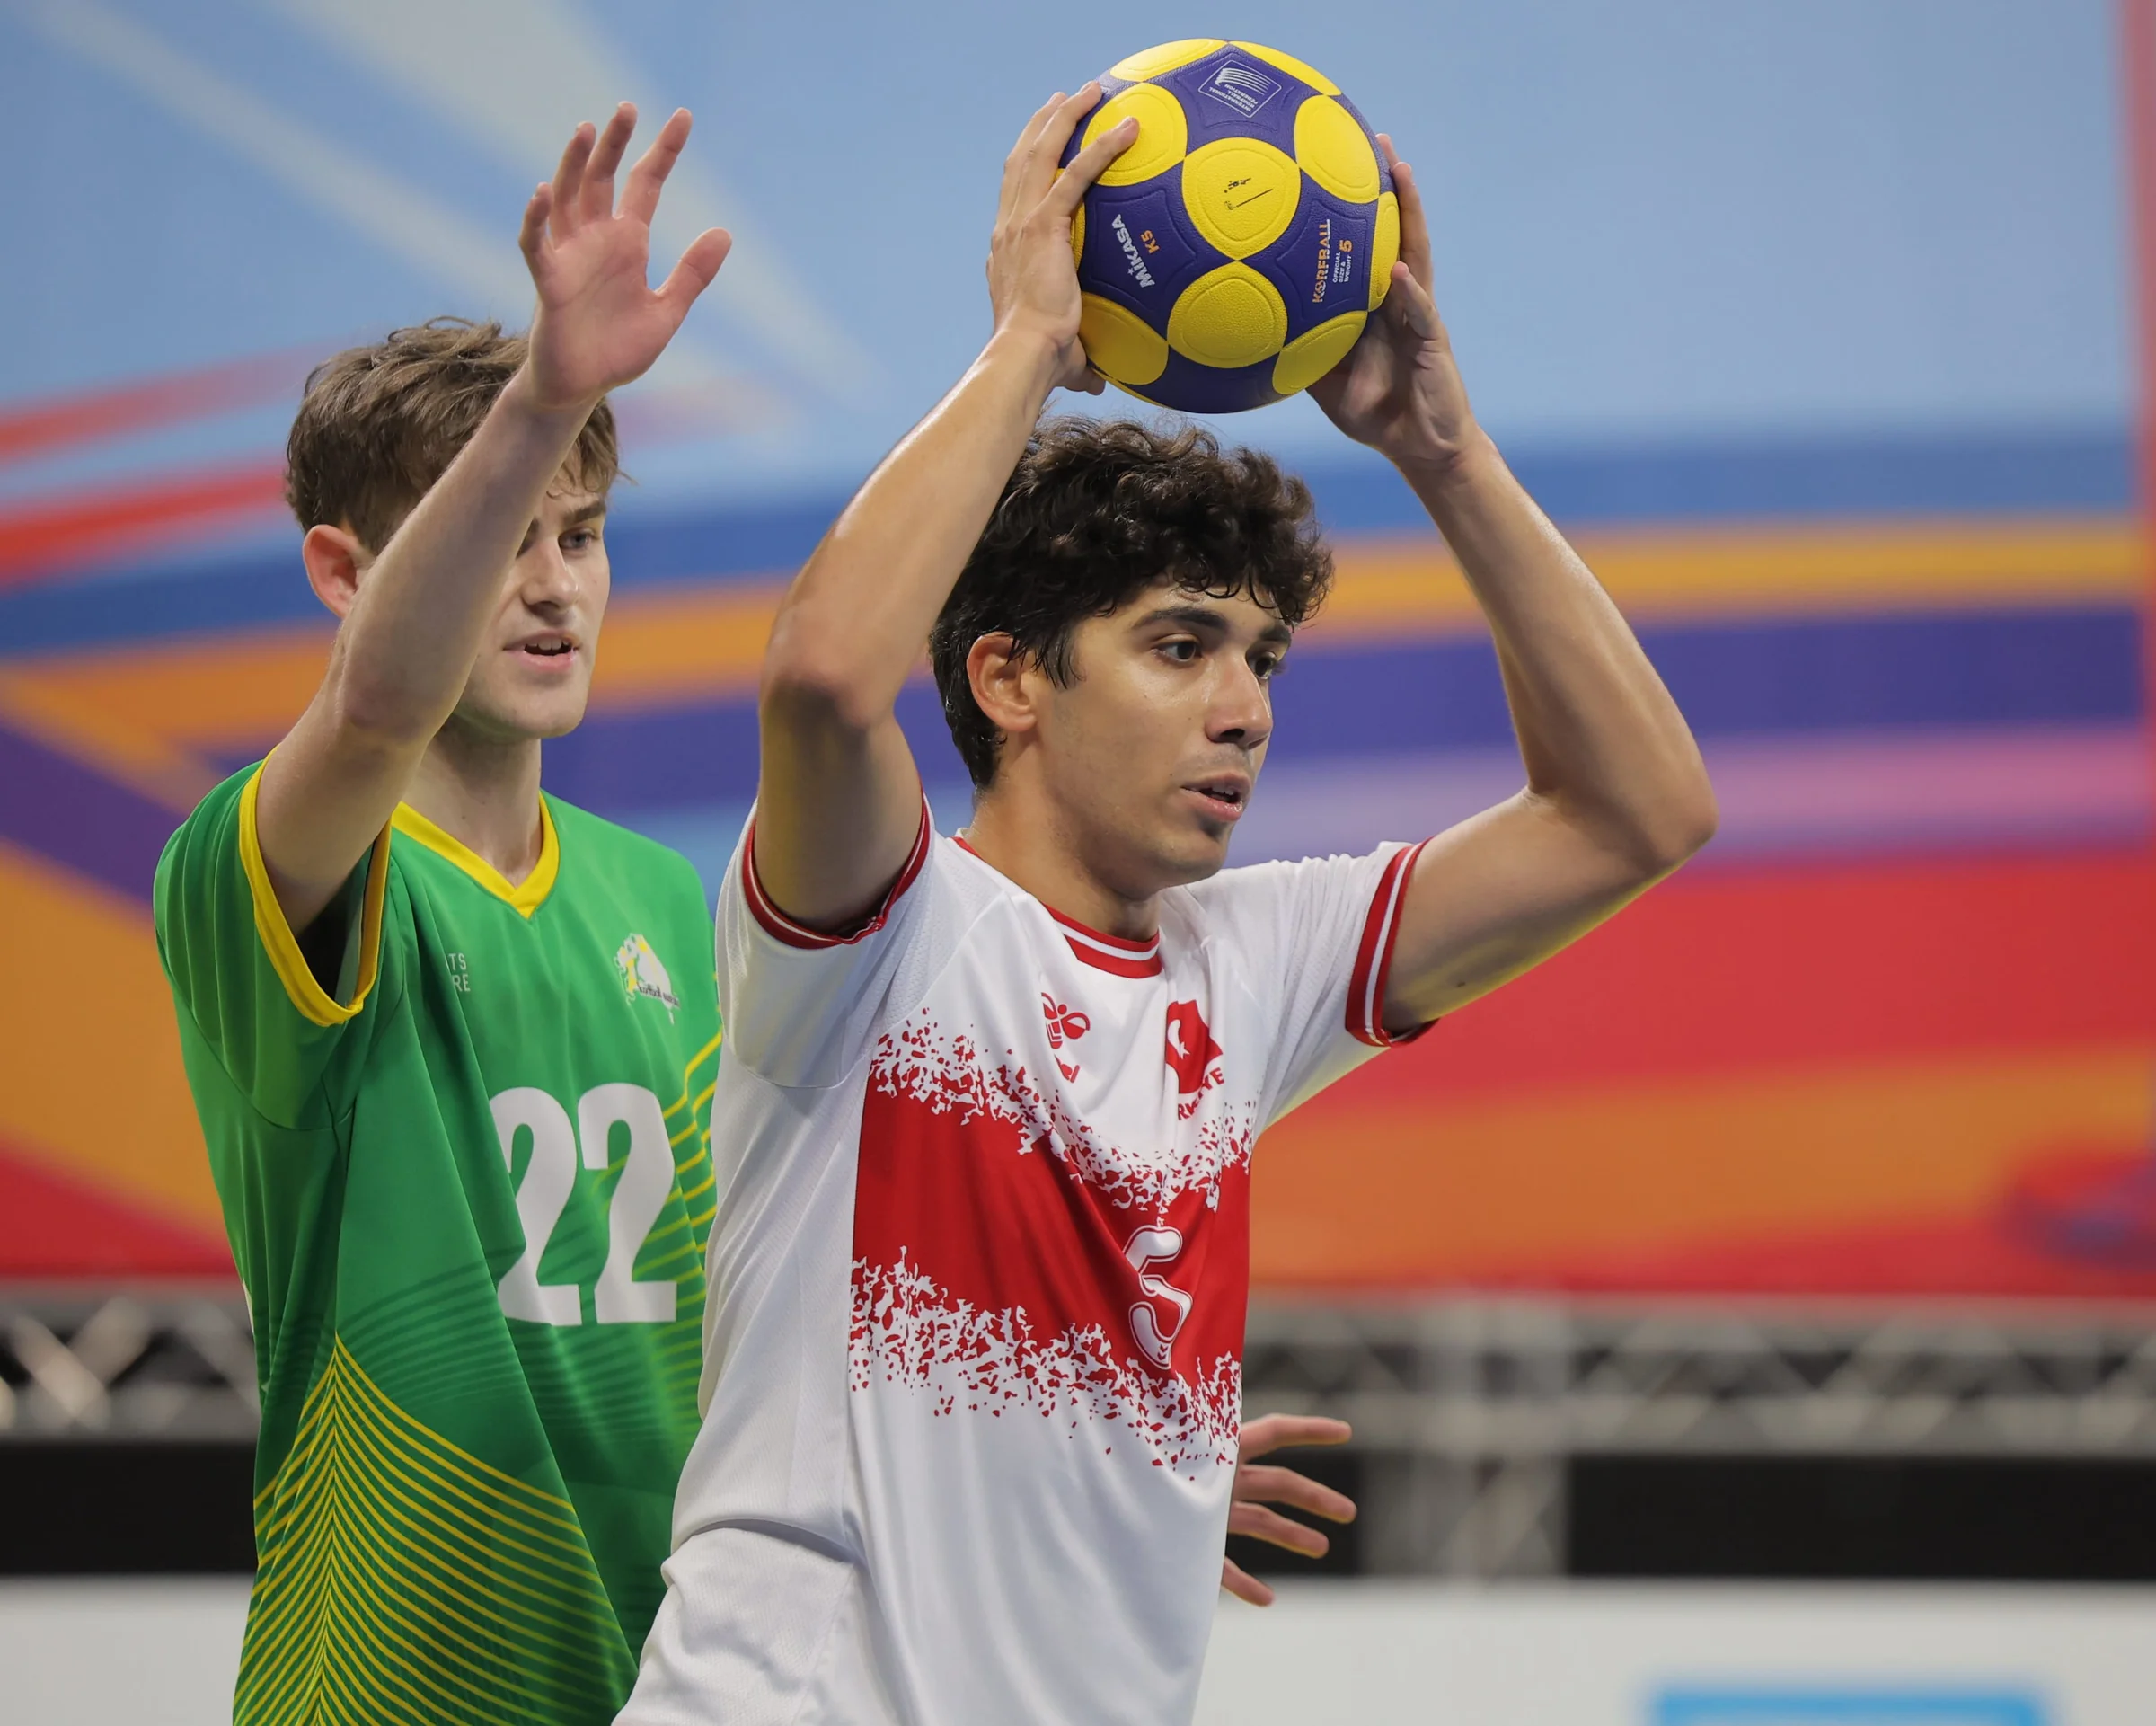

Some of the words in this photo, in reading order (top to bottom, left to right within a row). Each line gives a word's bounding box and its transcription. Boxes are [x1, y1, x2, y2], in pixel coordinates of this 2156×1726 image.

[1209, 86, 1251, 111] INTERNATIONAL
[1224, 84, 1259, 105] FEDERATION
[1140, 230, 1160, 253] K5
[1339, 239, 1353, 252] 5
[1312, 219, 1330, 302] KORFBALL
[1332, 252, 1341, 283] OFFICIAL
[1344, 255, 1352, 282] WEIGHT
[489, 1082, 677, 1326] 22
[1123, 1225, 1193, 1370] 5
